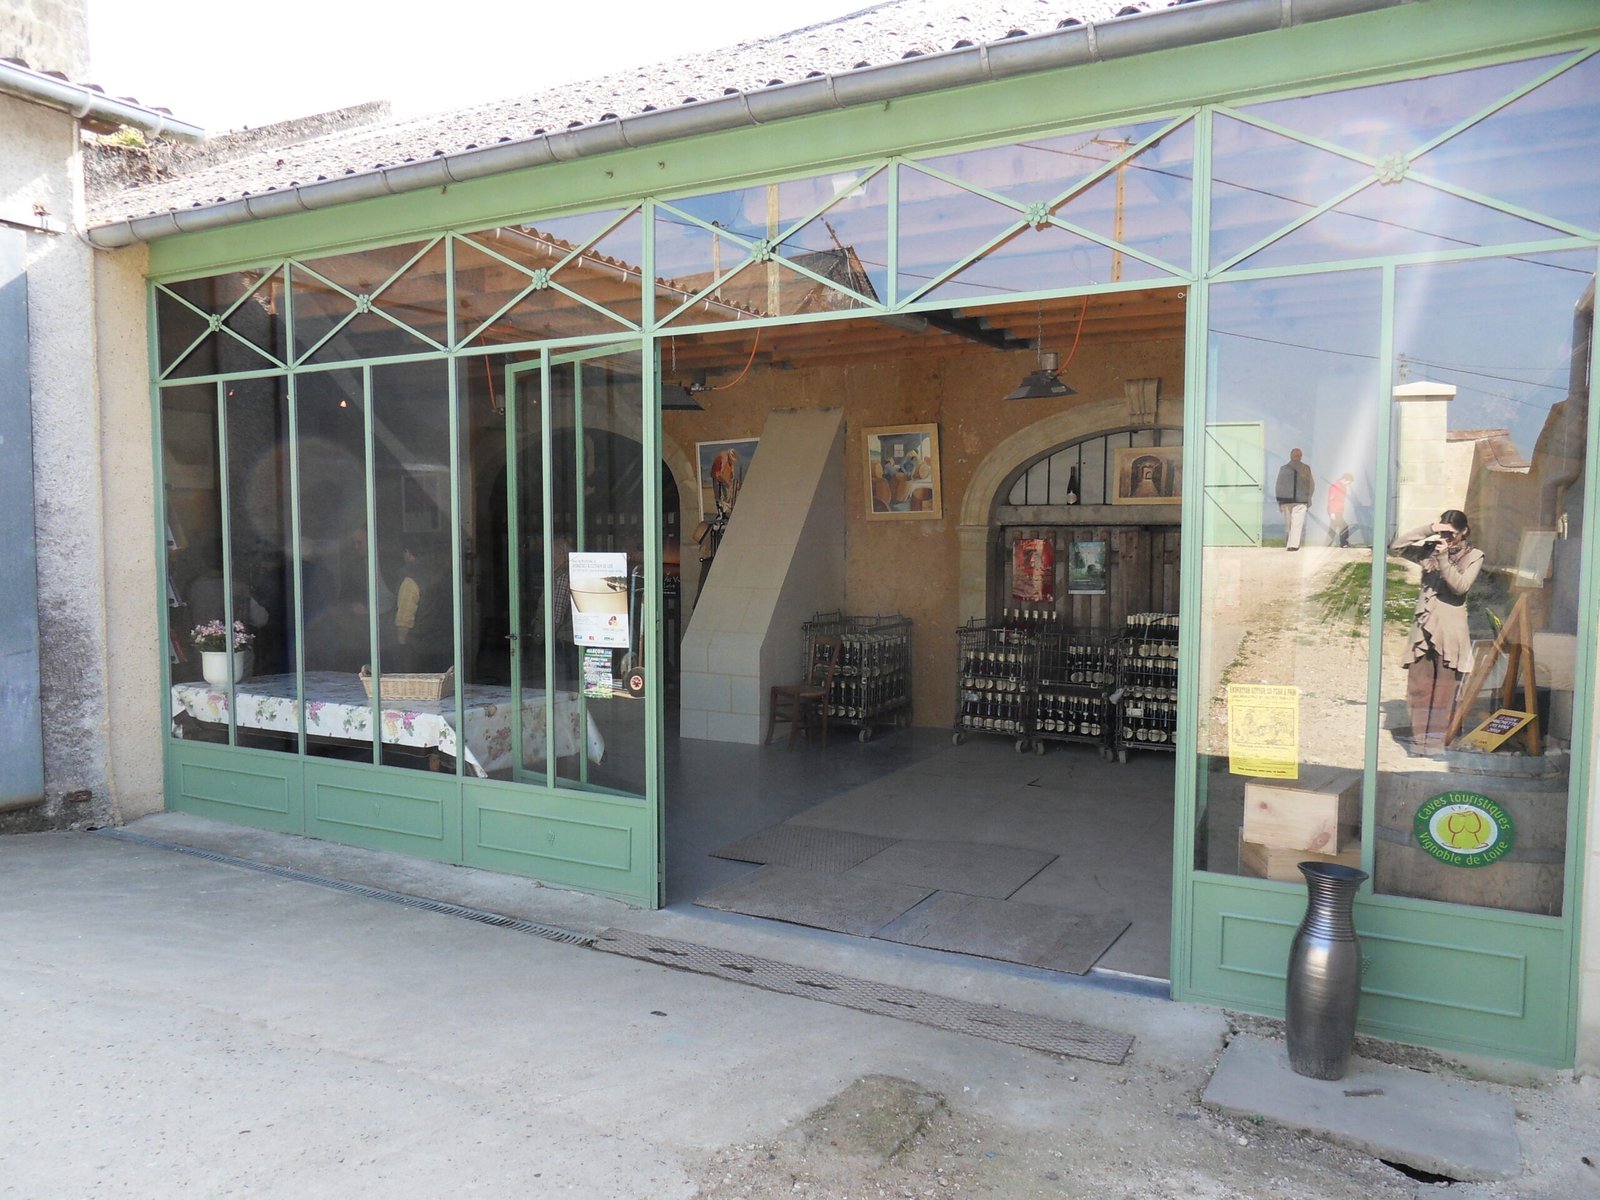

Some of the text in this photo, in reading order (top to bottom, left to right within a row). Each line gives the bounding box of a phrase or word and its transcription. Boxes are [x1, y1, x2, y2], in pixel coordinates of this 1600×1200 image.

[1418, 793, 1510, 830] Caves touristiques
[1420, 831, 1508, 865] Vignoble de Loire
